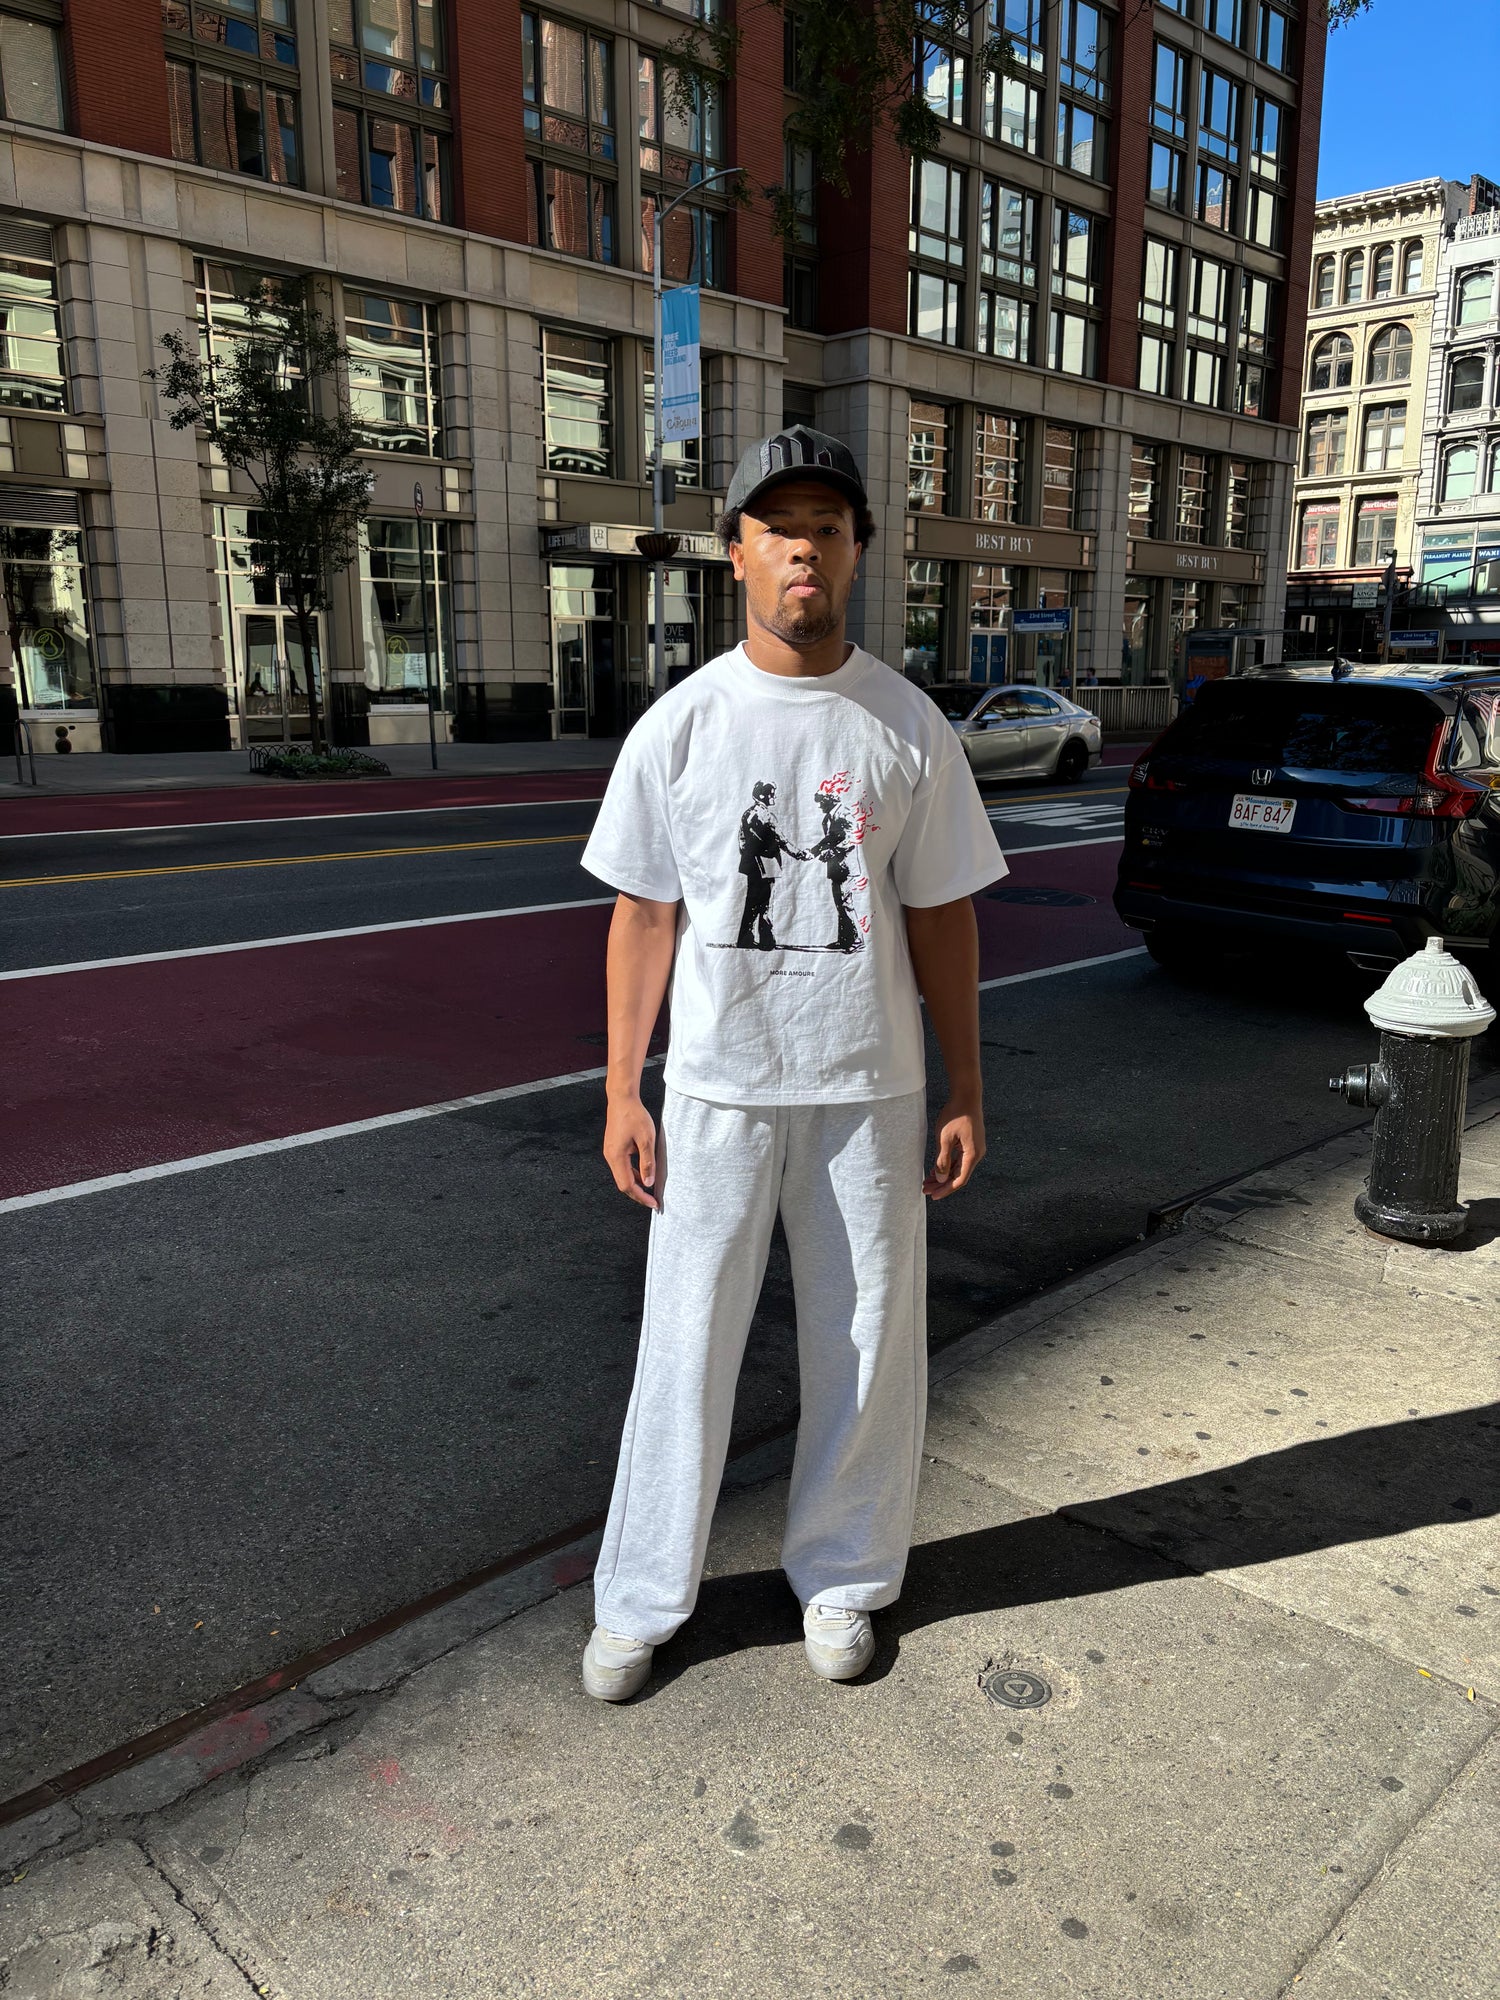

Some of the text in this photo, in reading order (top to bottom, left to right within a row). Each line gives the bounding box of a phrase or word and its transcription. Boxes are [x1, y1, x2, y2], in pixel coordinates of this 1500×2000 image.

[548, 533, 577, 548] LIFETIME
[976, 533, 1034, 553] BEST BUY
[1176, 553, 1220, 570] BEST BUY
[664, 625, 684, 636] OVE
[1233, 803, 1261, 821] 8AF
[1263, 806, 1292, 824] 847
